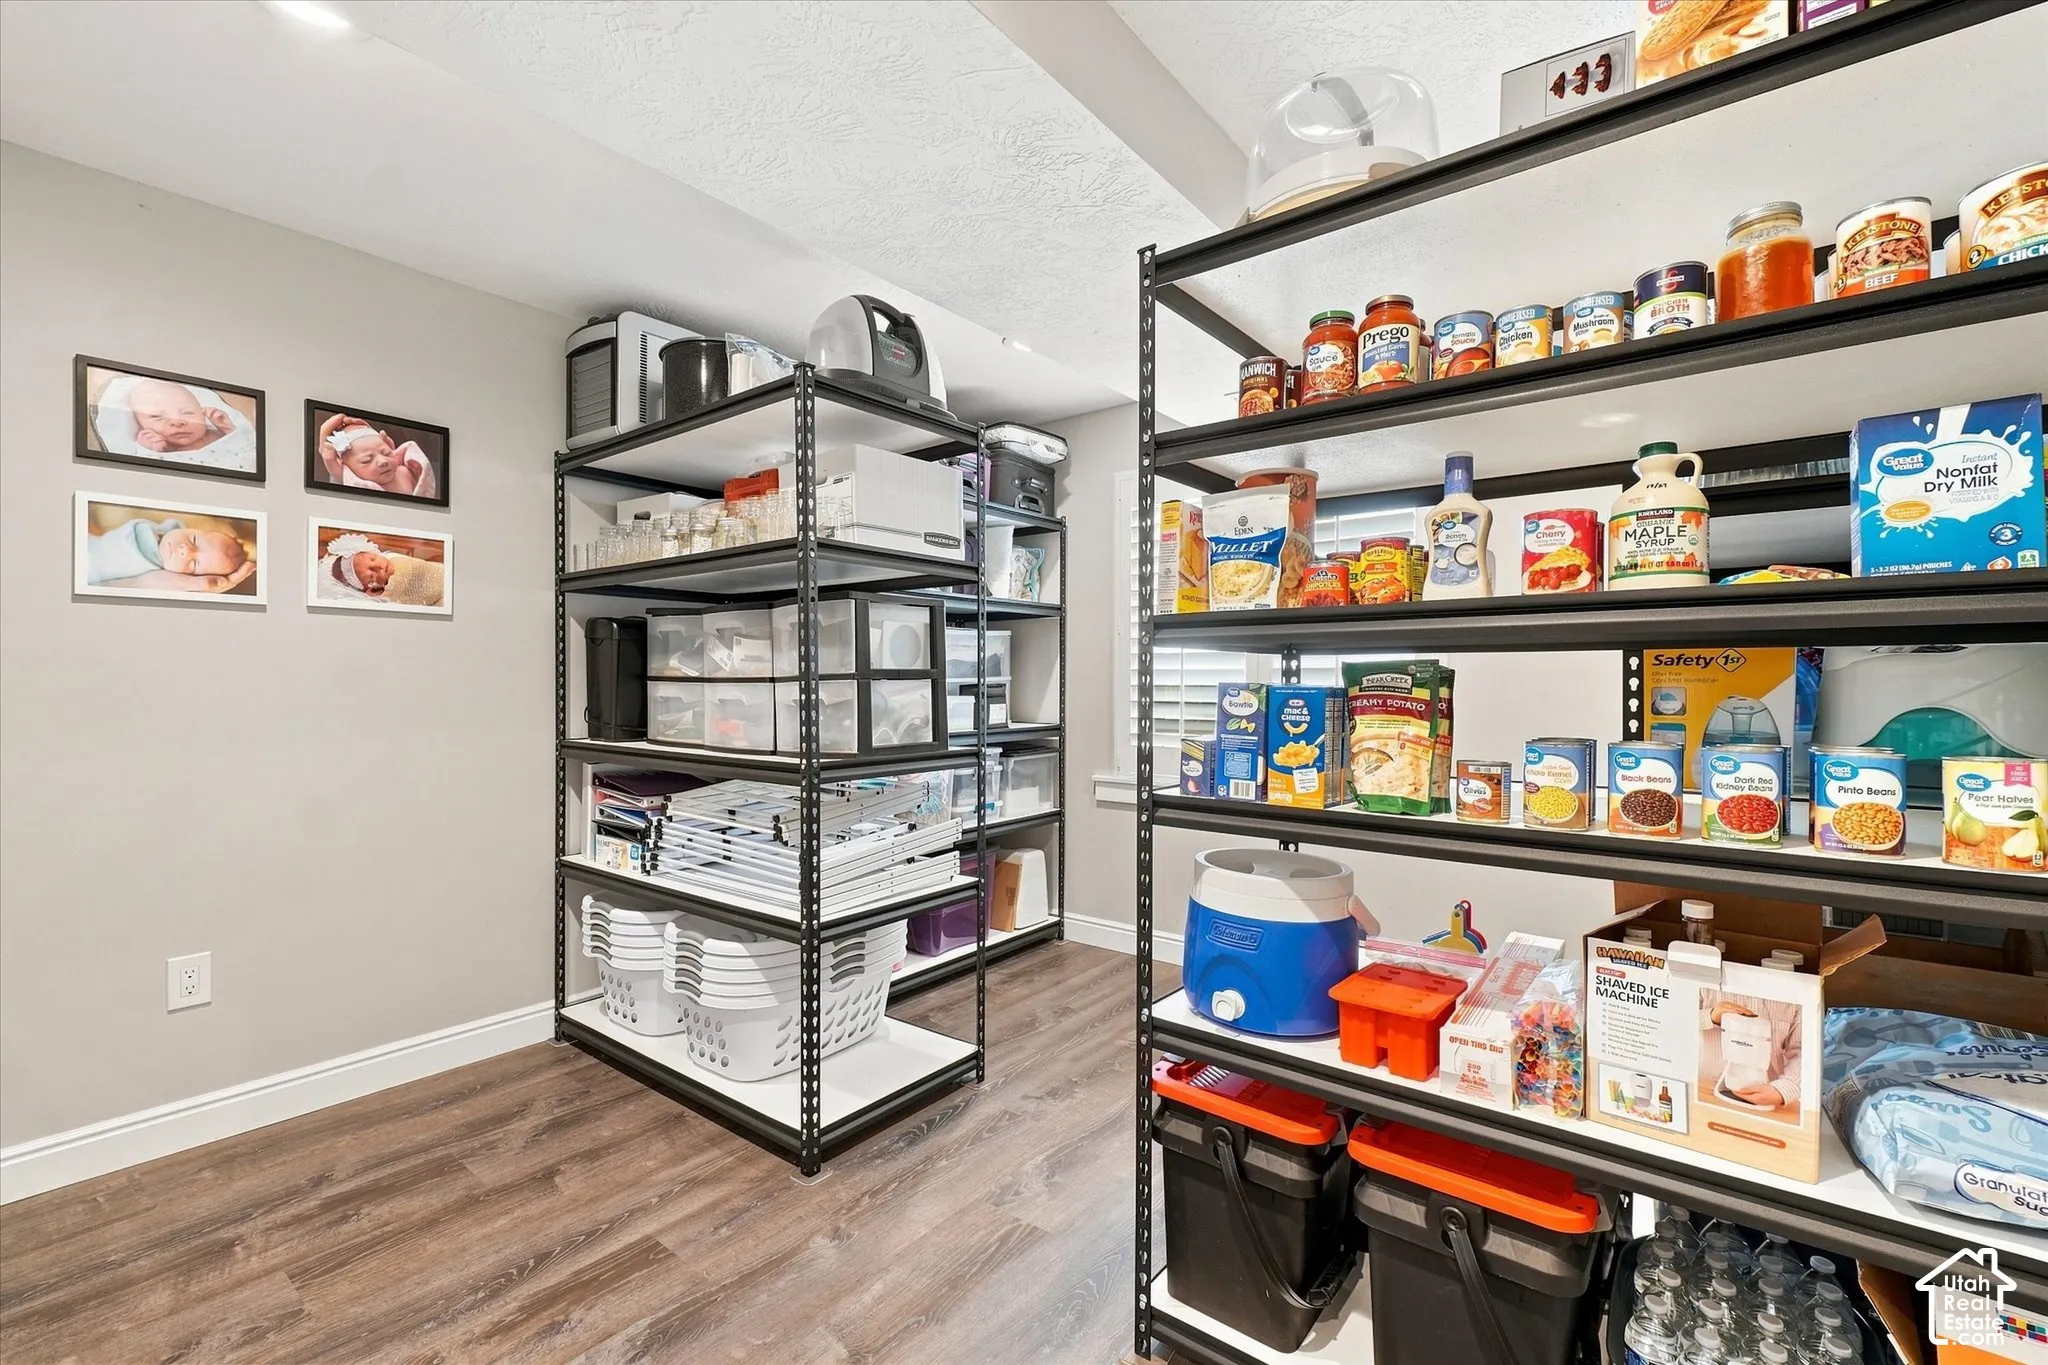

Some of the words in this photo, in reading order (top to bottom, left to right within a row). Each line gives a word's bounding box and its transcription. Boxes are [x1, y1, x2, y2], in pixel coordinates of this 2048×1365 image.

[1845, 220, 1919, 249] KEYSTONE
[1865, 273, 1899, 288] BEEF
[1653, 299, 1688, 309] CHICKEN
[1650, 304, 1690, 317] BROTH
[1573, 319, 1614, 331] Mushroom
[1363, 327, 1409, 350] Prego
[1451, 338, 1476, 346] Sauce
[1499, 331, 1533, 347] Chicken
[1388, 343, 1407, 351] Garlic
[1309, 355, 1338, 367] Sauce
[1883, 453, 1924, 466] Great
[1961, 453, 1998, 464] Instant
[1893, 463, 1926, 472] Value
[1936, 463, 1998, 480] Nonfat
[1924, 481, 1954, 493] Dry
[1961, 475, 1998, 490] Milk
[1638, 509, 1673, 517] KIRKLAND
[1637, 519, 1675, 528] ORGANIC
[1234, 527, 1254, 536] EDEN
[1536, 530, 1566, 539] Cherry
[1624, 525, 1687, 542] MAPLE
[2000, 528, 2012, 540] 3
[1211, 541, 1274, 554] MILLET
[1636, 538, 1675, 548] SYRUP
[1923, 561, 1952, 570] POUCHES
[1651, 654, 1715, 669] Safety
[1387, 699, 1426, 711] POTATO
[1826, 764, 1851, 772] Great
[1621, 774, 1644, 782] Black
[1647, 776, 1672, 784] Beans
[1734, 776, 1755, 784] Dark
[1463, 787, 1486, 795] Olives
[1716, 782, 1745, 792] Kidney
[1838, 786, 1864, 795] Pinto
[1867, 787, 1896, 796] Beans
[1968, 793, 1994, 802] Pear
[1997, 795, 2034, 804] Halves
[1596, 946, 1665, 969] HAWAIIAN
[1613, 958, 1635, 966] SHAVED
[1636, 961, 1647, 969] ICE
[1596, 975, 1646, 994] SHAVED
[1650, 986, 1670, 999] ICE
[1596, 986, 1659, 1008] MACHINE
[1449, 1035, 1470, 1048] OPEN
[1471, 1039, 1488, 1051] THIS
[1489, 1043, 1504, 1054] END
